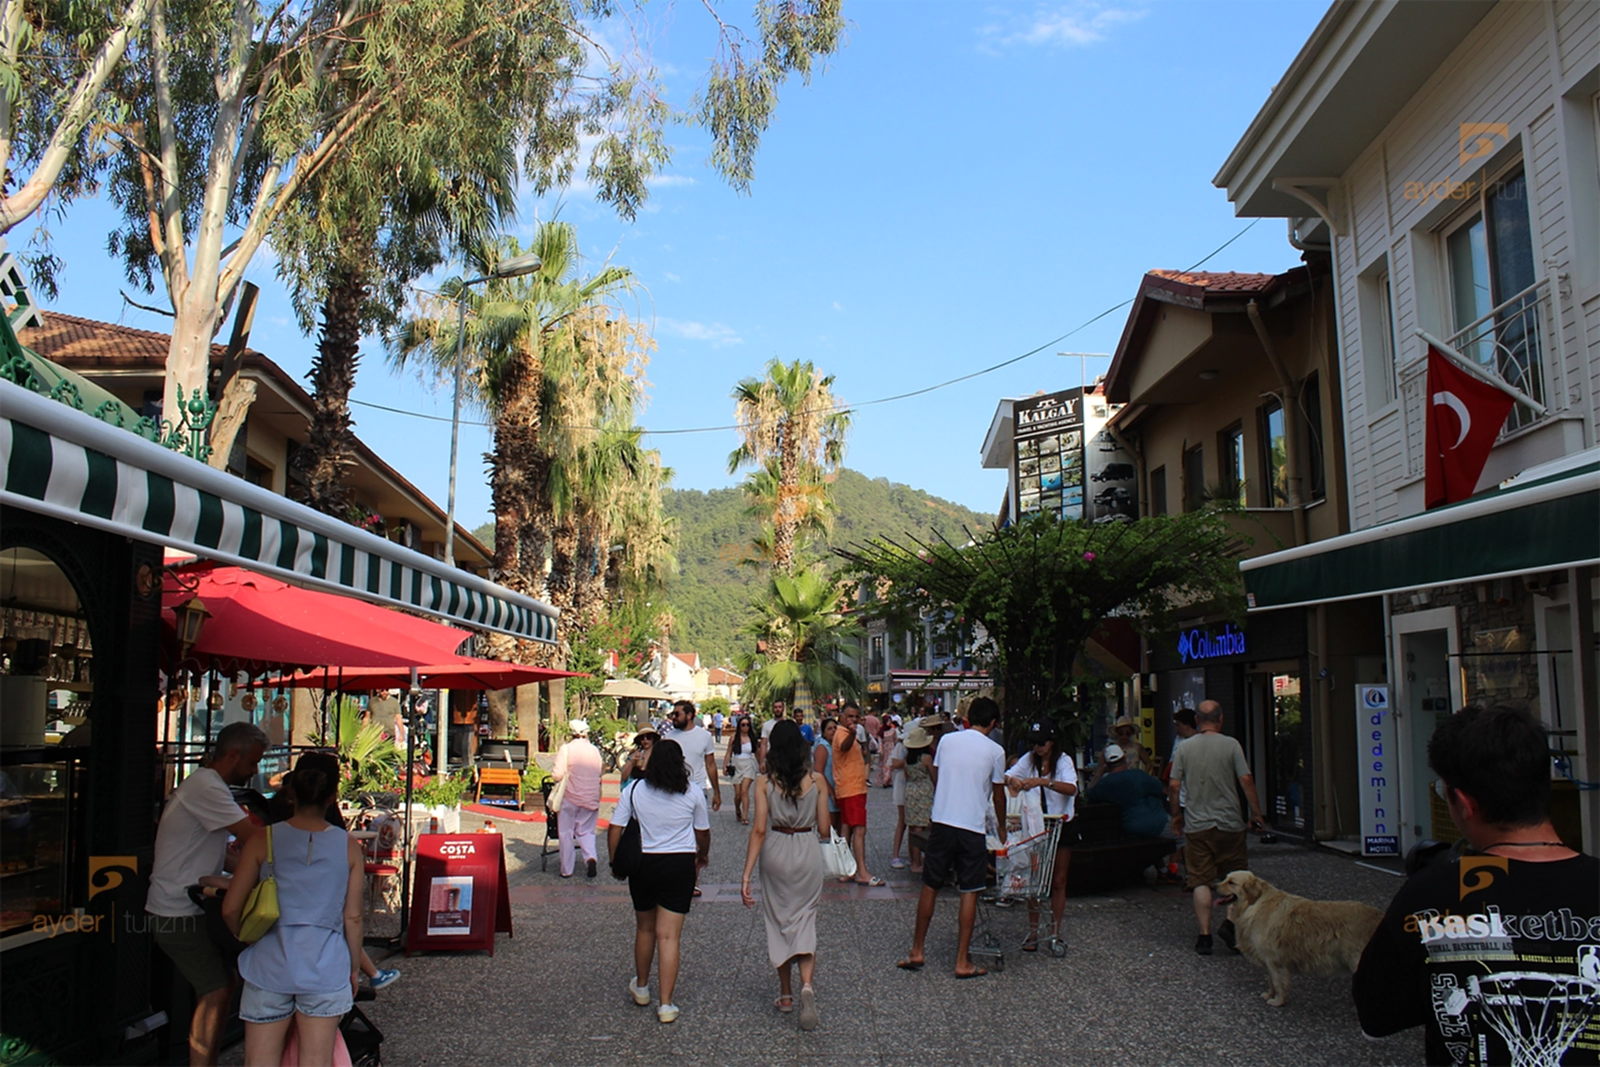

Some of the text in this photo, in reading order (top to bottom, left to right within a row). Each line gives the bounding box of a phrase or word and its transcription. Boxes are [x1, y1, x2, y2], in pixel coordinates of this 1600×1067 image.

[1019, 397, 1079, 425] KALGAY
[1189, 623, 1246, 660] Columbia
[439, 845, 476, 855] COSTA
[1452, 942, 1500, 952] BASKETBALL
[1520, 954, 1554, 963] BASKETBALL
[1554, 956, 1574, 964] LEAGUE
